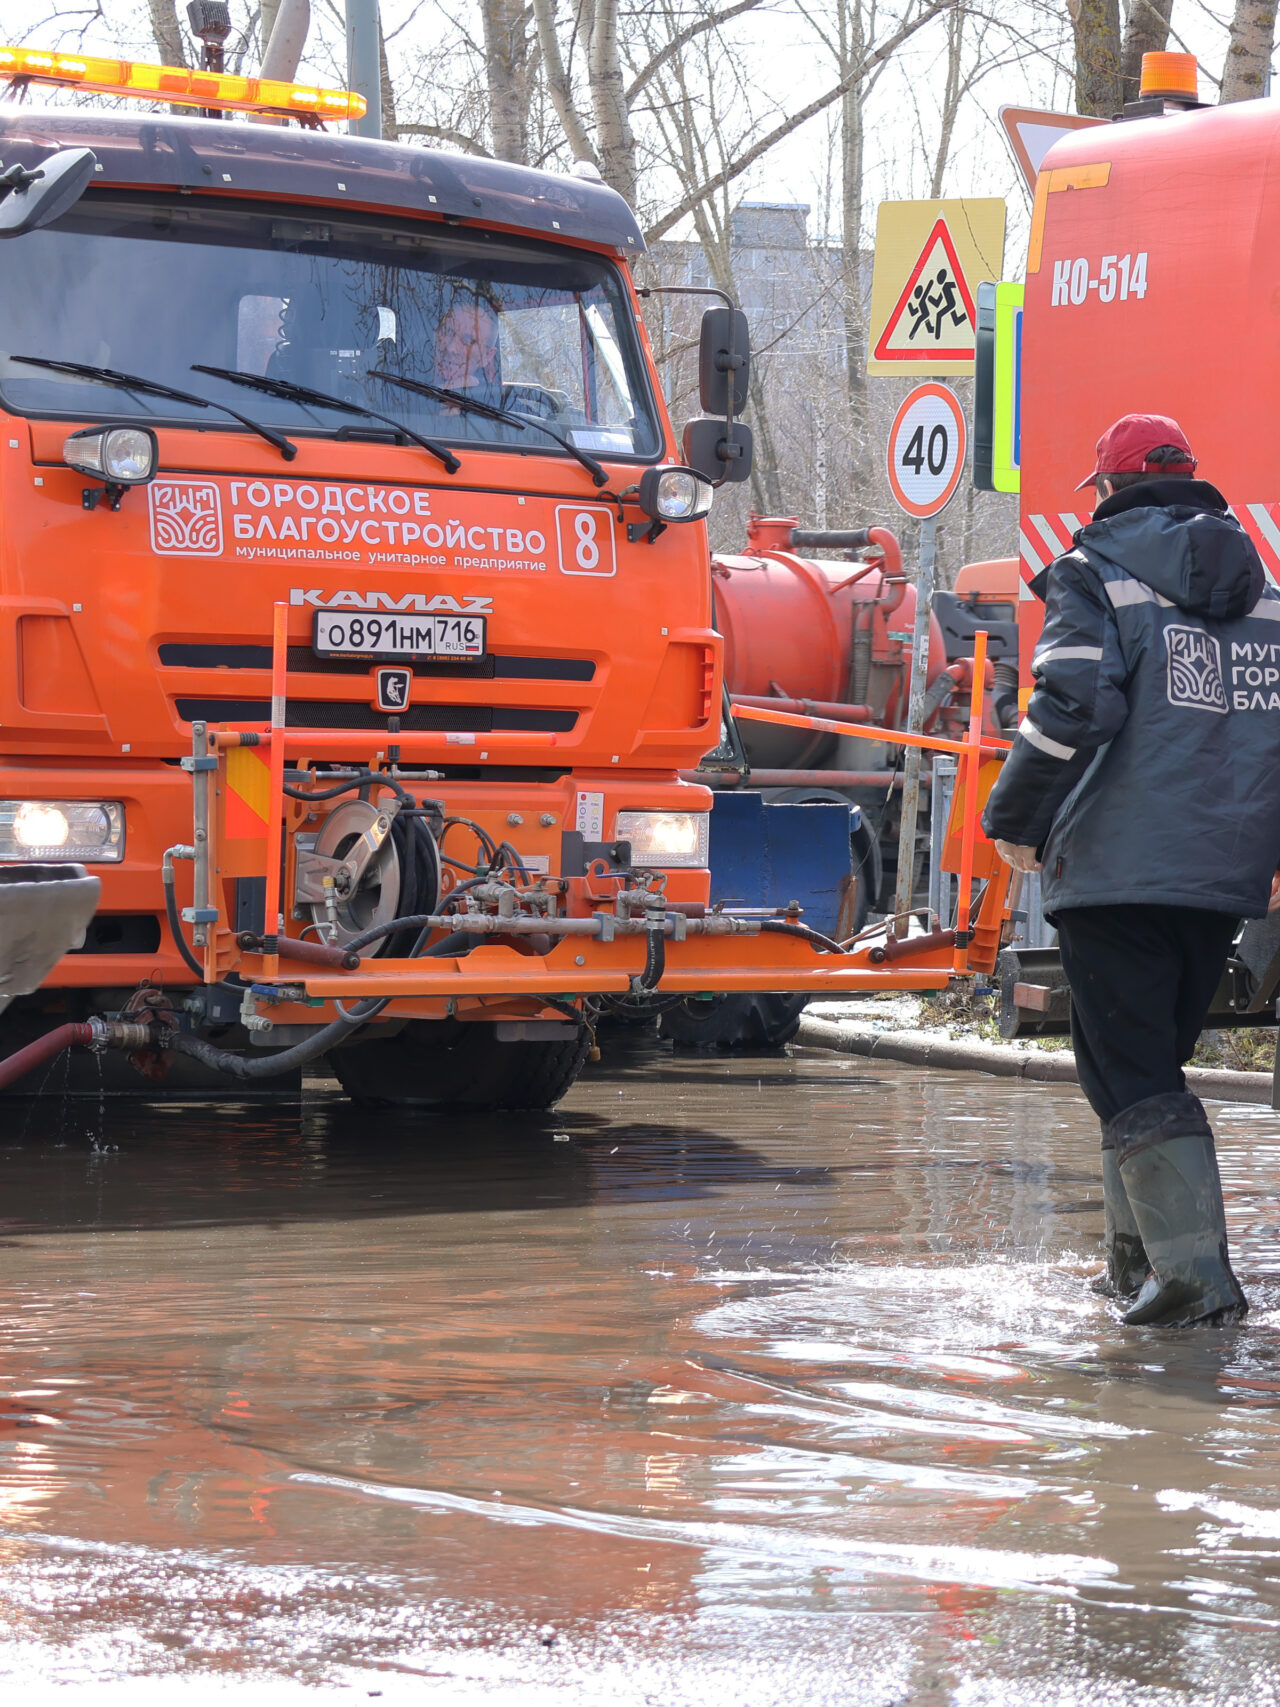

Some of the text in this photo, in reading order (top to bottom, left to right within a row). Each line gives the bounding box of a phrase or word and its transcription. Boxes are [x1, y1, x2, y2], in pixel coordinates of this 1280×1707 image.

[1051, 252, 1148, 306] КО-514
[902, 424, 948, 476] 40
[230, 481, 431, 516] ГОРОДСКОЕ
[233, 514, 546, 554] БЛАГОУСТРОЙСТВО
[574, 512, 599, 569] 8
[236, 546, 547, 571] муниципальное унитарное предприятие
[289, 588, 494, 614] KAMAZ
[437, 620, 476, 643] 716
[445, 642, 465, 651] RUS
[1232, 666, 1280, 686] ГОР
